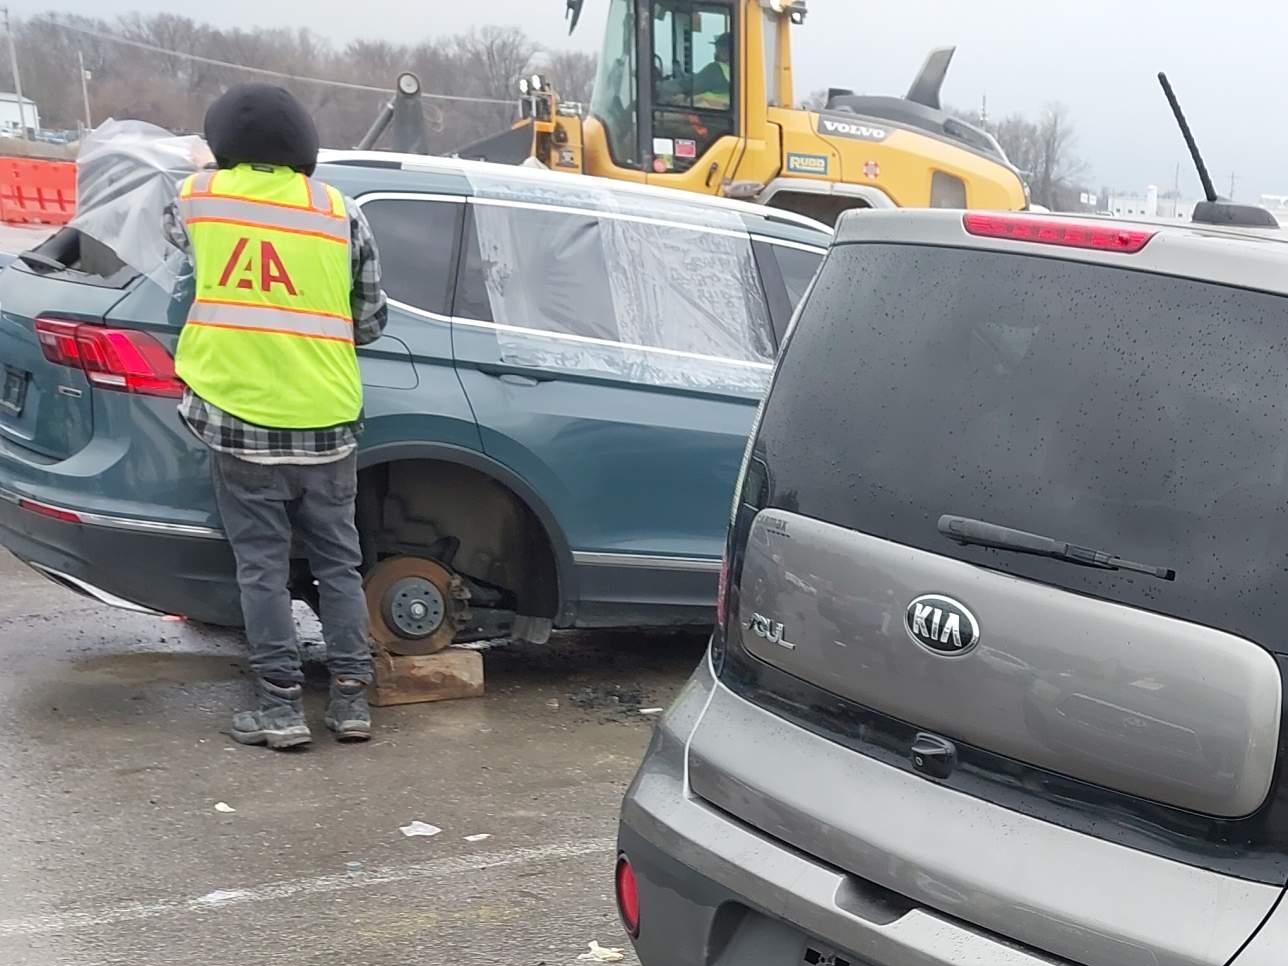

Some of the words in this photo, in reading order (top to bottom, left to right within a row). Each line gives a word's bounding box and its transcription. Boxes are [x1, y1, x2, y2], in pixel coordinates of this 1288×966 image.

[823, 120, 886, 138] VOLVO
[742, 612, 796, 650] SOUL
[913, 602, 962, 647] KIA
